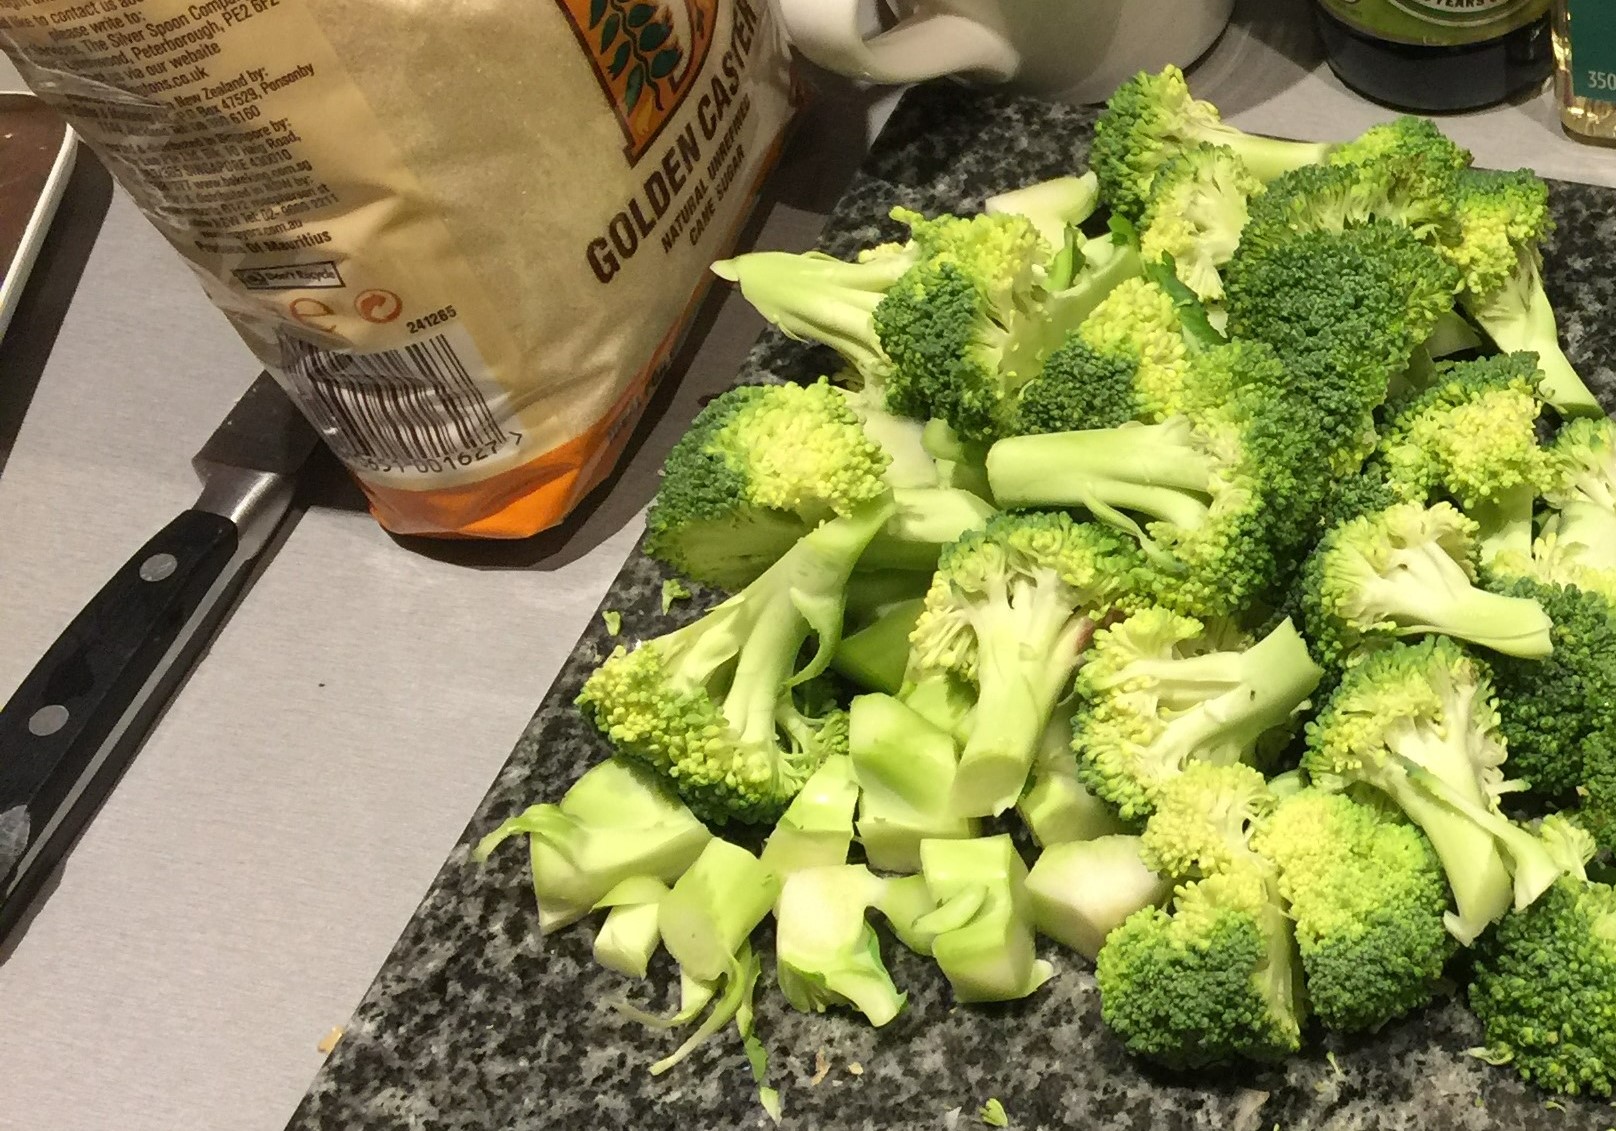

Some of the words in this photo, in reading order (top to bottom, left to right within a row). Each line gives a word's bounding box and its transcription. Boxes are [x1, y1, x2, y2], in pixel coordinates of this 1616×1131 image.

[32, 15, 49, 26] to
[50, 2, 98, 24] contact
[103, 0, 118, 12] us
[82, 37, 109, 53] The
[107, 28, 145, 48] Silver
[145, 13, 190, 37] Spoon
[188, 0, 243, 21] Compa
[89, 16, 125, 34] write
[124, 11, 146, 26] to:
[130, 19, 225, 61] Peterborough,
[221, 3, 253, 27] PE2
[123, 65, 145, 80] via
[145, 60, 168, 76] our
[169, 41, 222, 69] website
[174, 93, 202, 108] New
[201, 70, 248, 102] Zealand
[246, 65, 269, 84] by:
[221, 87, 262, 111] 47529,
[258, 62, 315, 96] Ponsonby
[229, 104, 261, 124] 6160
[269, 117, 292, 132] by:
[265, 129, 302, 150] Road,
[660, 178, 709, 254] NATURAL
[706, 91, 751, 182] UNREFINED
[585, 121, 701, 285] GOLDEN
[688, 196, 717, 247] CANE
[713, 143, 746, 202] SUGAR
[262, 230, 333, 252] Mauritius
